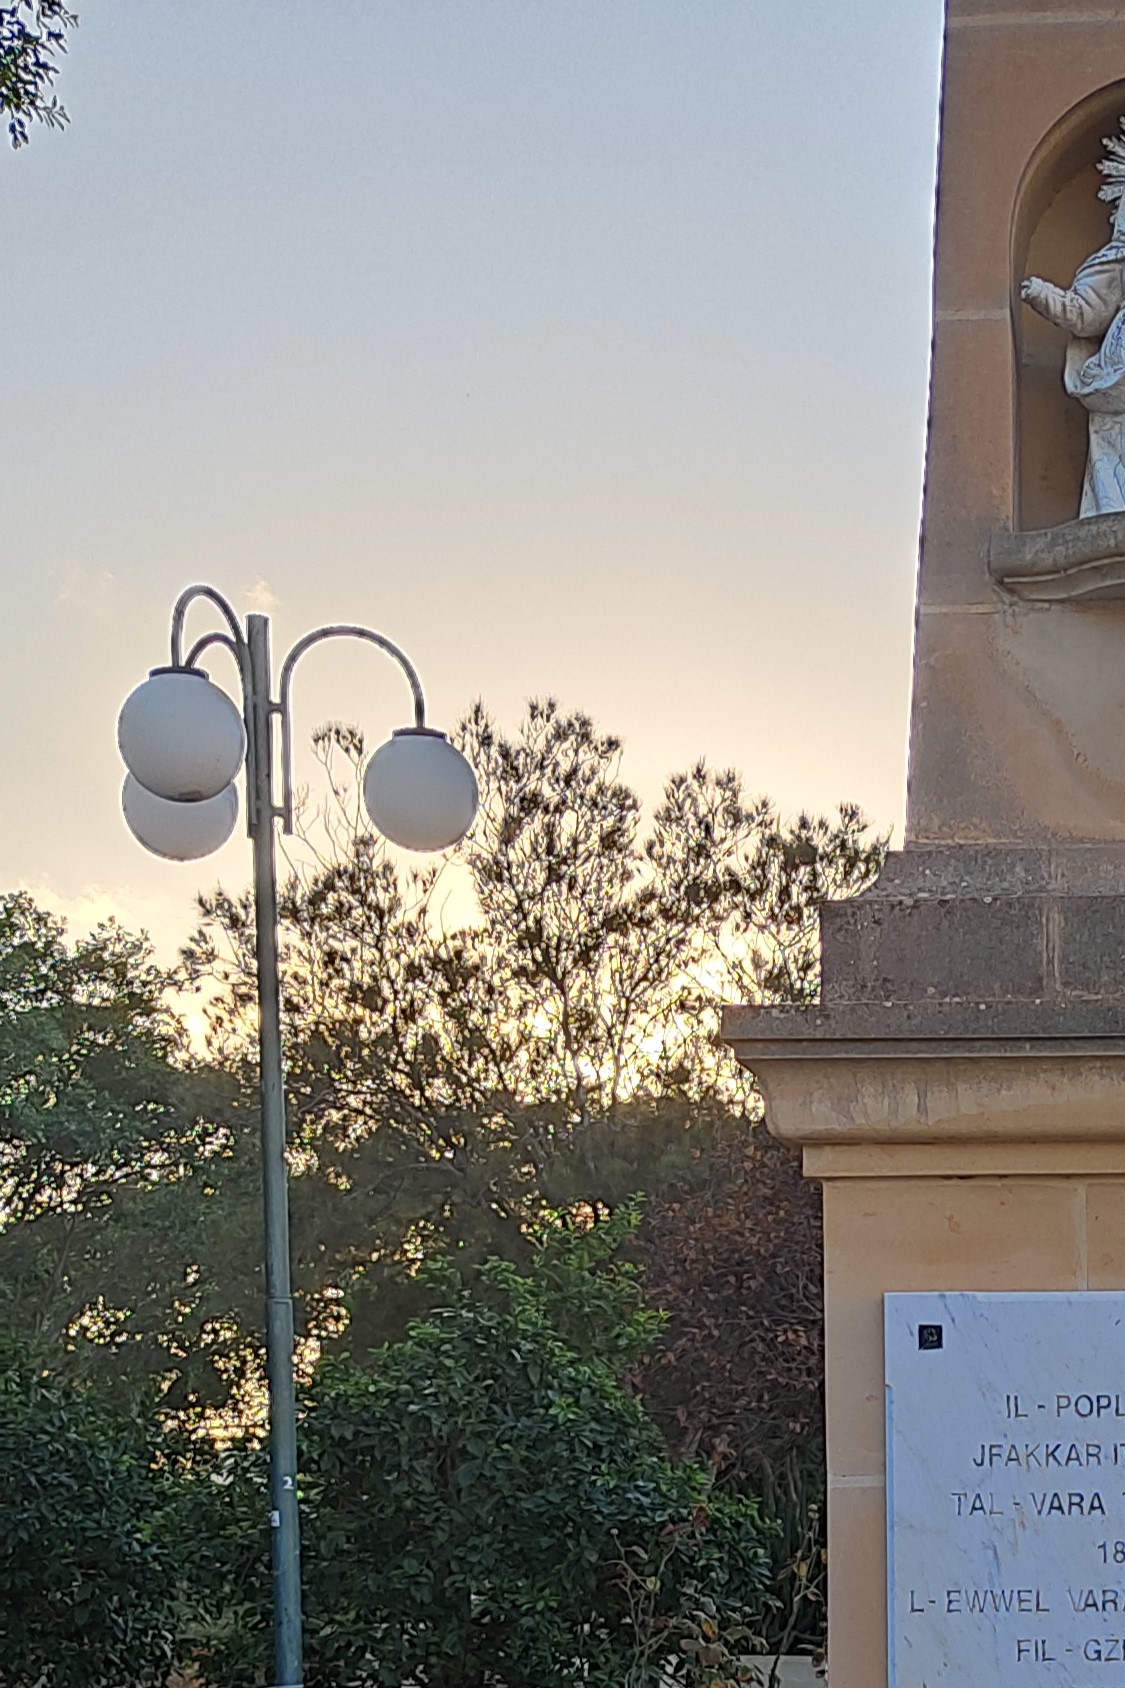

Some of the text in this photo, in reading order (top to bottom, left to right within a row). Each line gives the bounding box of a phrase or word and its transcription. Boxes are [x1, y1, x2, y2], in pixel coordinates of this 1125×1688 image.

[972, 1443, 1101, 1468] JFAKKAR
[282, 1475, 295, 1490] 2
[1030, 1492, 1106, 1516] VARA
